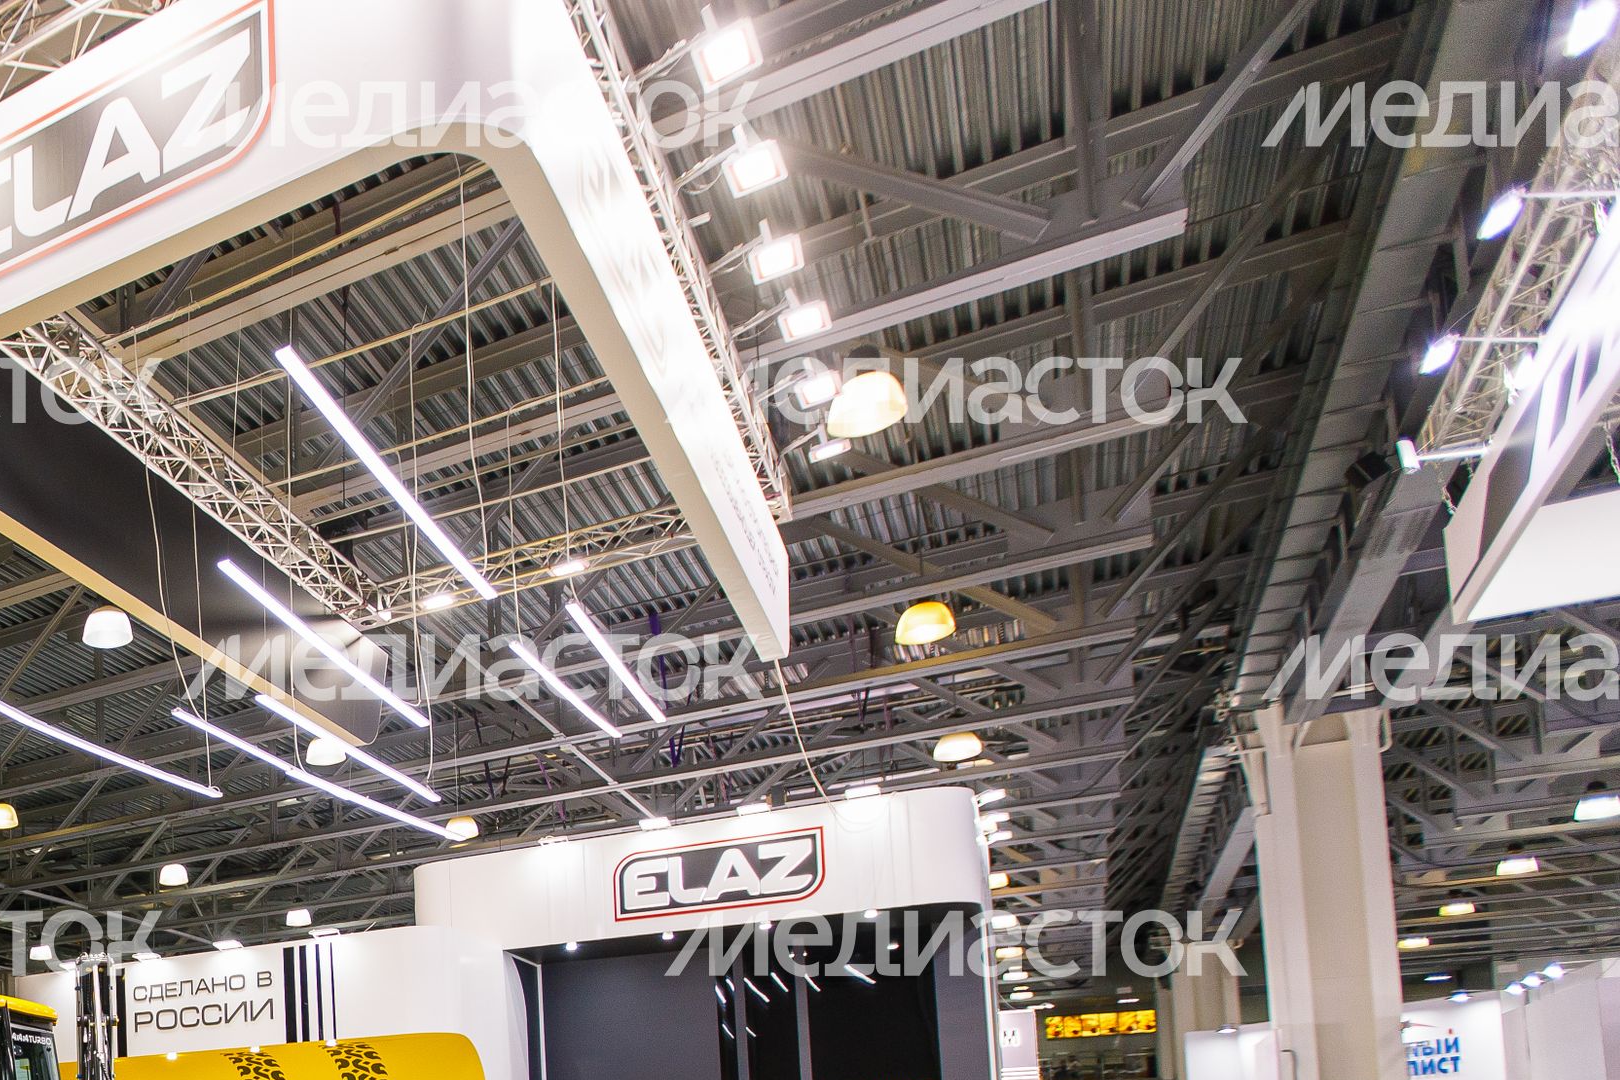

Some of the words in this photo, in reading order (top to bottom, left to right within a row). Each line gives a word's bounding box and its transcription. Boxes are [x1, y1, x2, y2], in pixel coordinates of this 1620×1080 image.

[623, 838, 813, 910] ELAZ
[133, 974, 246, 1003] СДЕЛАНО
[257, 971, 273, 988] В
[134, 998, 274, 1033] РОССИИ
